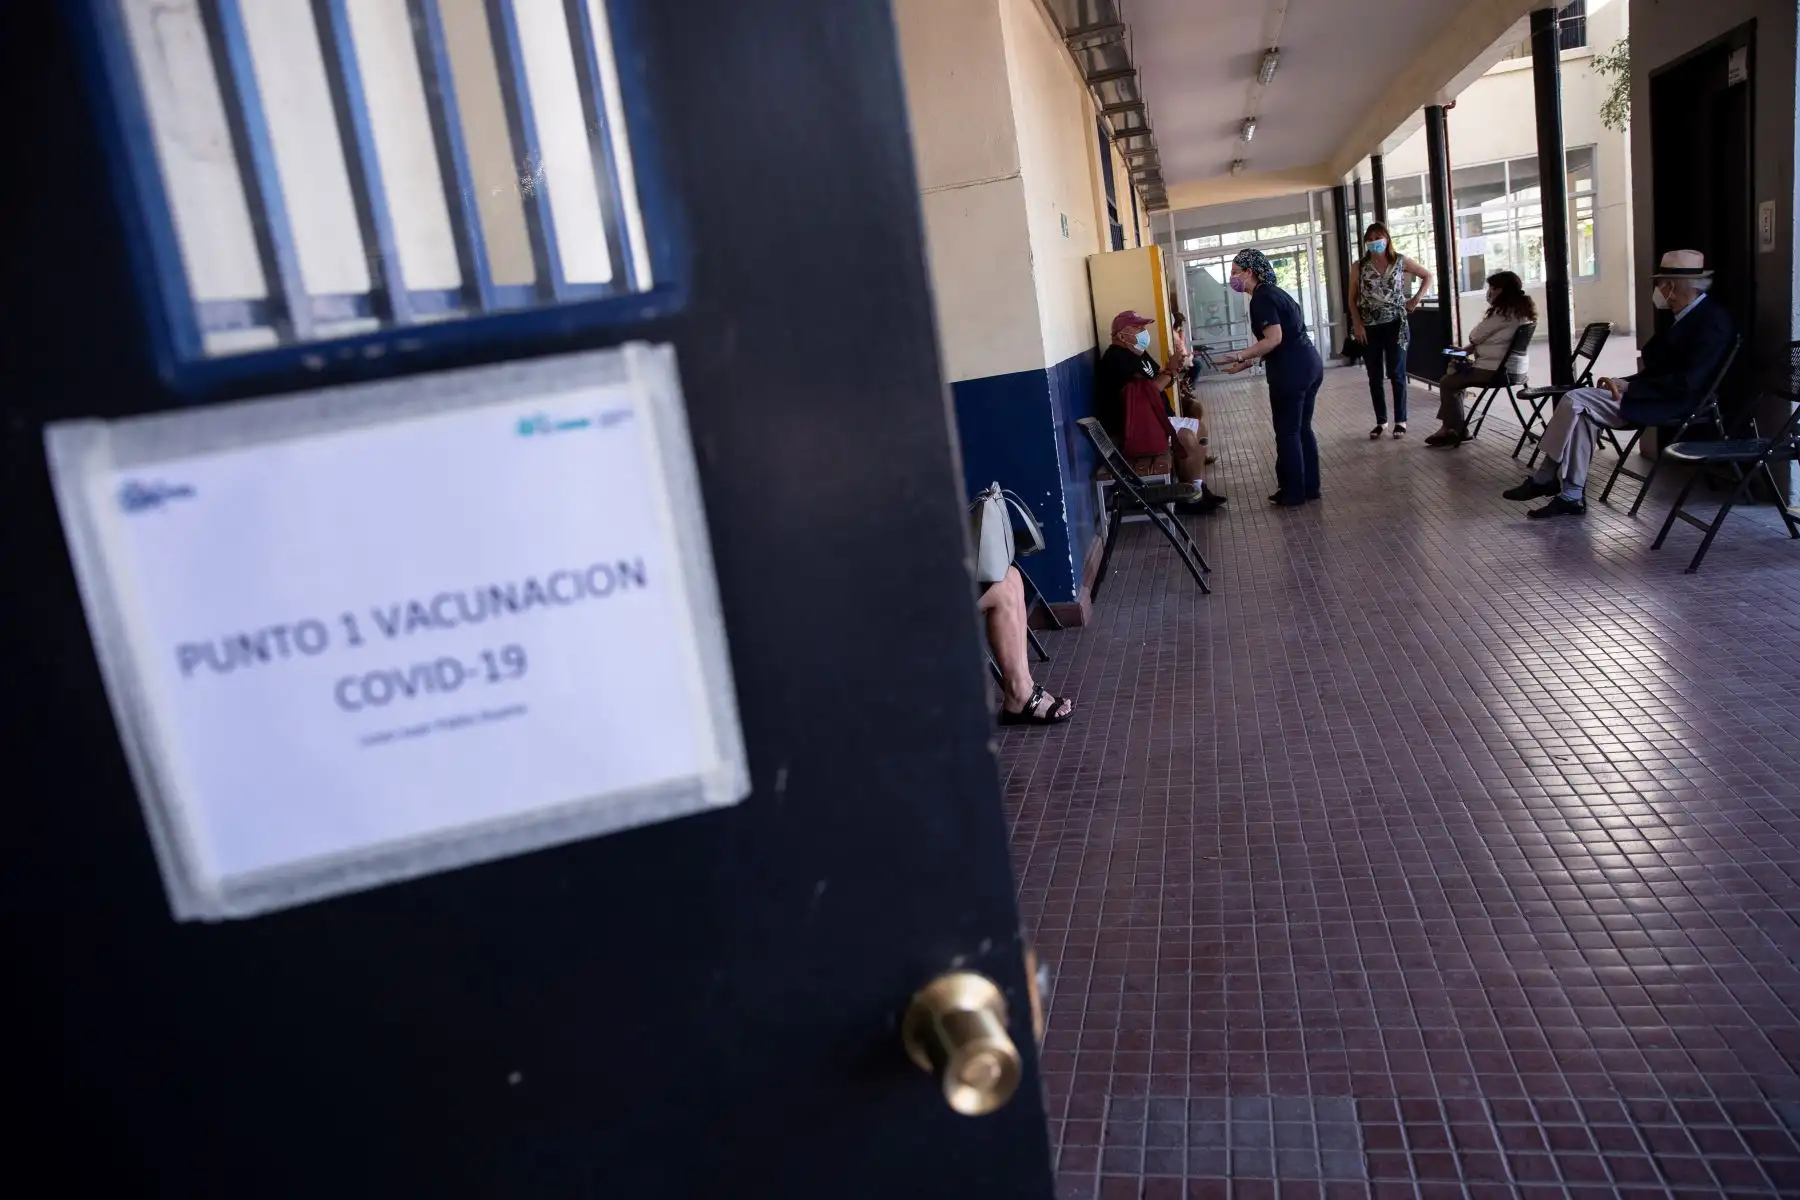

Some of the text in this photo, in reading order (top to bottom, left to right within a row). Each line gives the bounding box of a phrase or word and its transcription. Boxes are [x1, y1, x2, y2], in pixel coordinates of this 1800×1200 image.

[176, 556, 647, 679] PUNTO 1 VACUNACION
[333, 643, 528, 712] COVID-19
